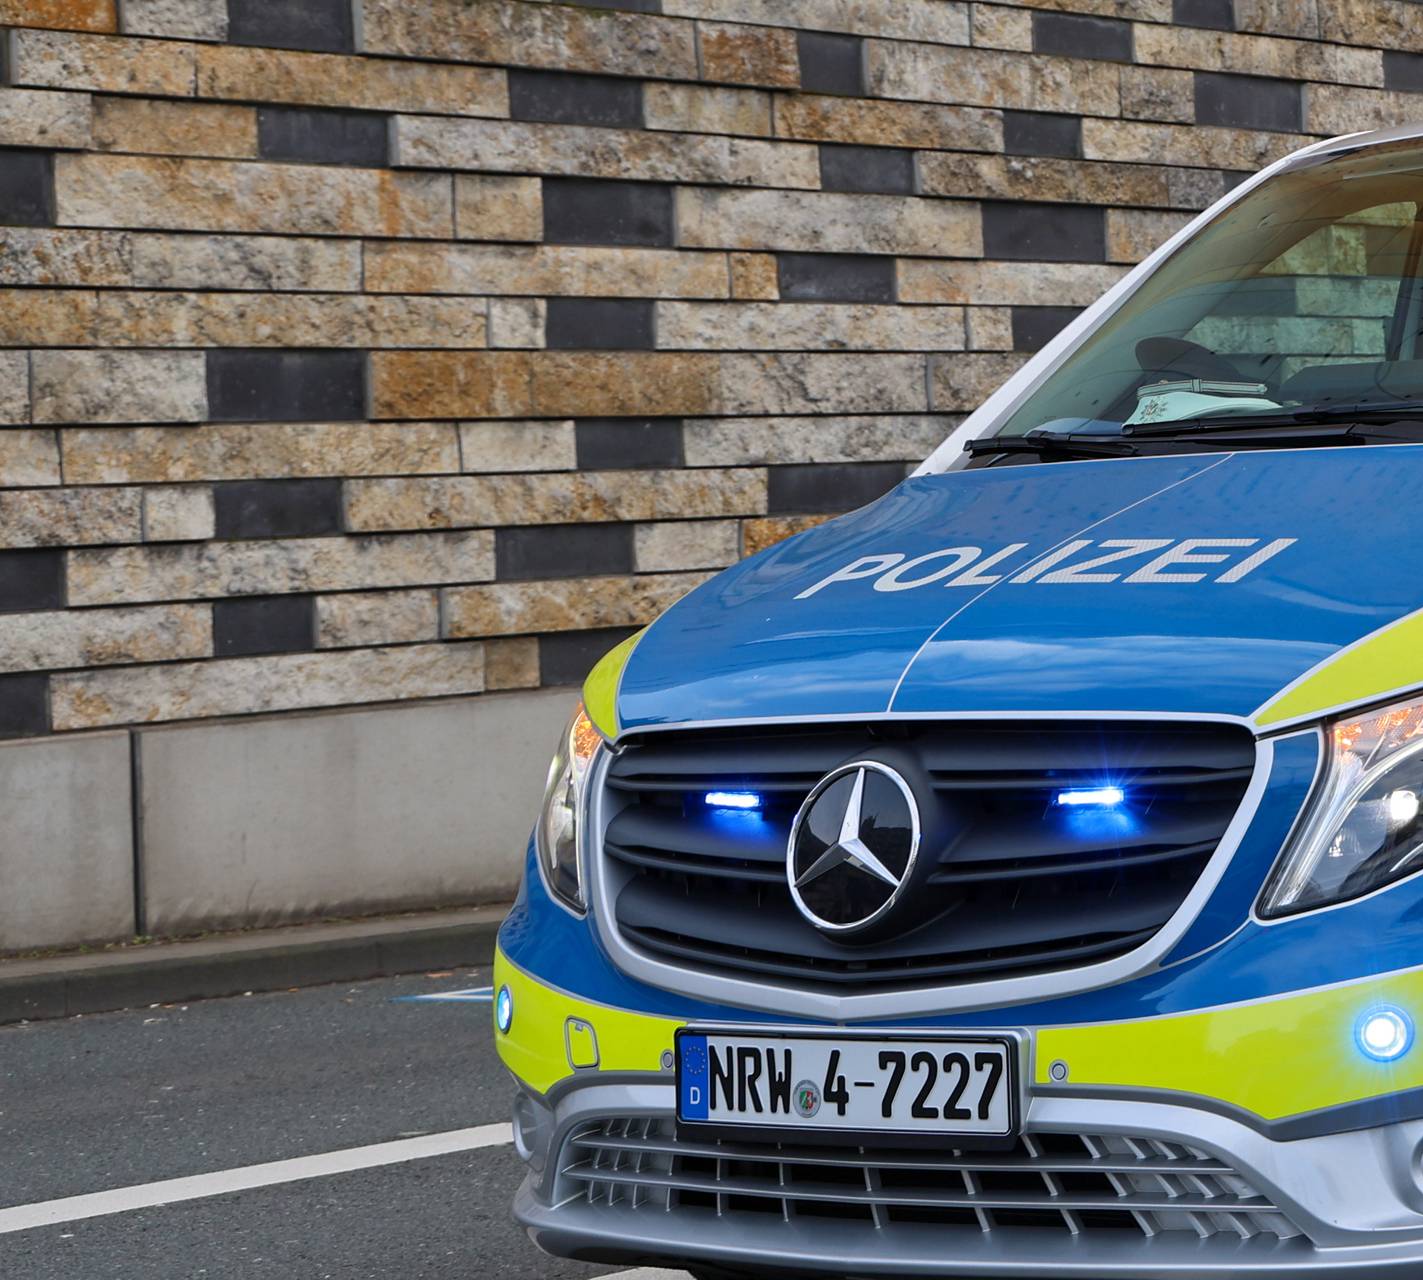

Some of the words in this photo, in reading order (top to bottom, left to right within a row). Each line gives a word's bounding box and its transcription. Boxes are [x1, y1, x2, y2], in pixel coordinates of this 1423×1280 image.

[793, 538, 1298, 599] POLIZEI
[689, 1086, 701, 1106] D
[708, 1044, 792, 1114] NRW
[822, 1049, 1003, 1120] 4-7227
